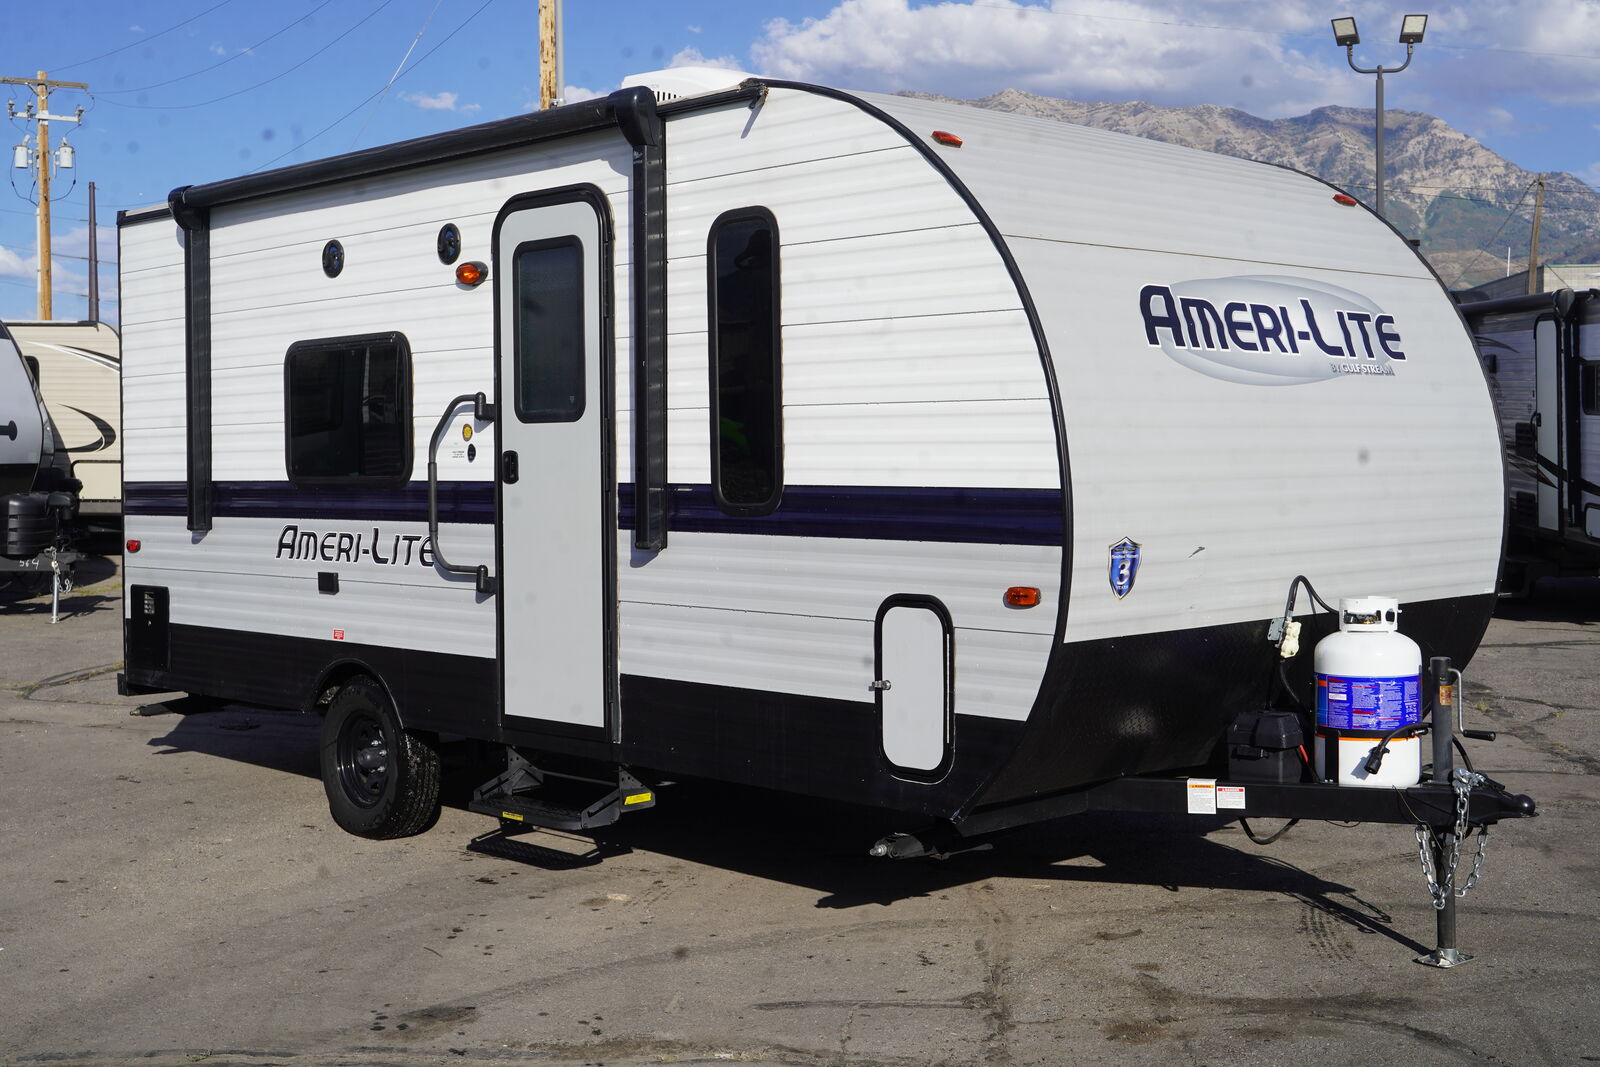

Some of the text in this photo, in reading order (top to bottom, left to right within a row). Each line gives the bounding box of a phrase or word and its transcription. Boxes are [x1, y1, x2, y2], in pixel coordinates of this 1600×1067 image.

[1139, 284, 1407, 361] AMERI-LITE
[1342, 363, 1360, 374] GULF
[1361, 363, 1396, 376] STREAM
[275, 524, 435, 567] AMERI-LITE
[1116, 559, 1131, 585] 3
